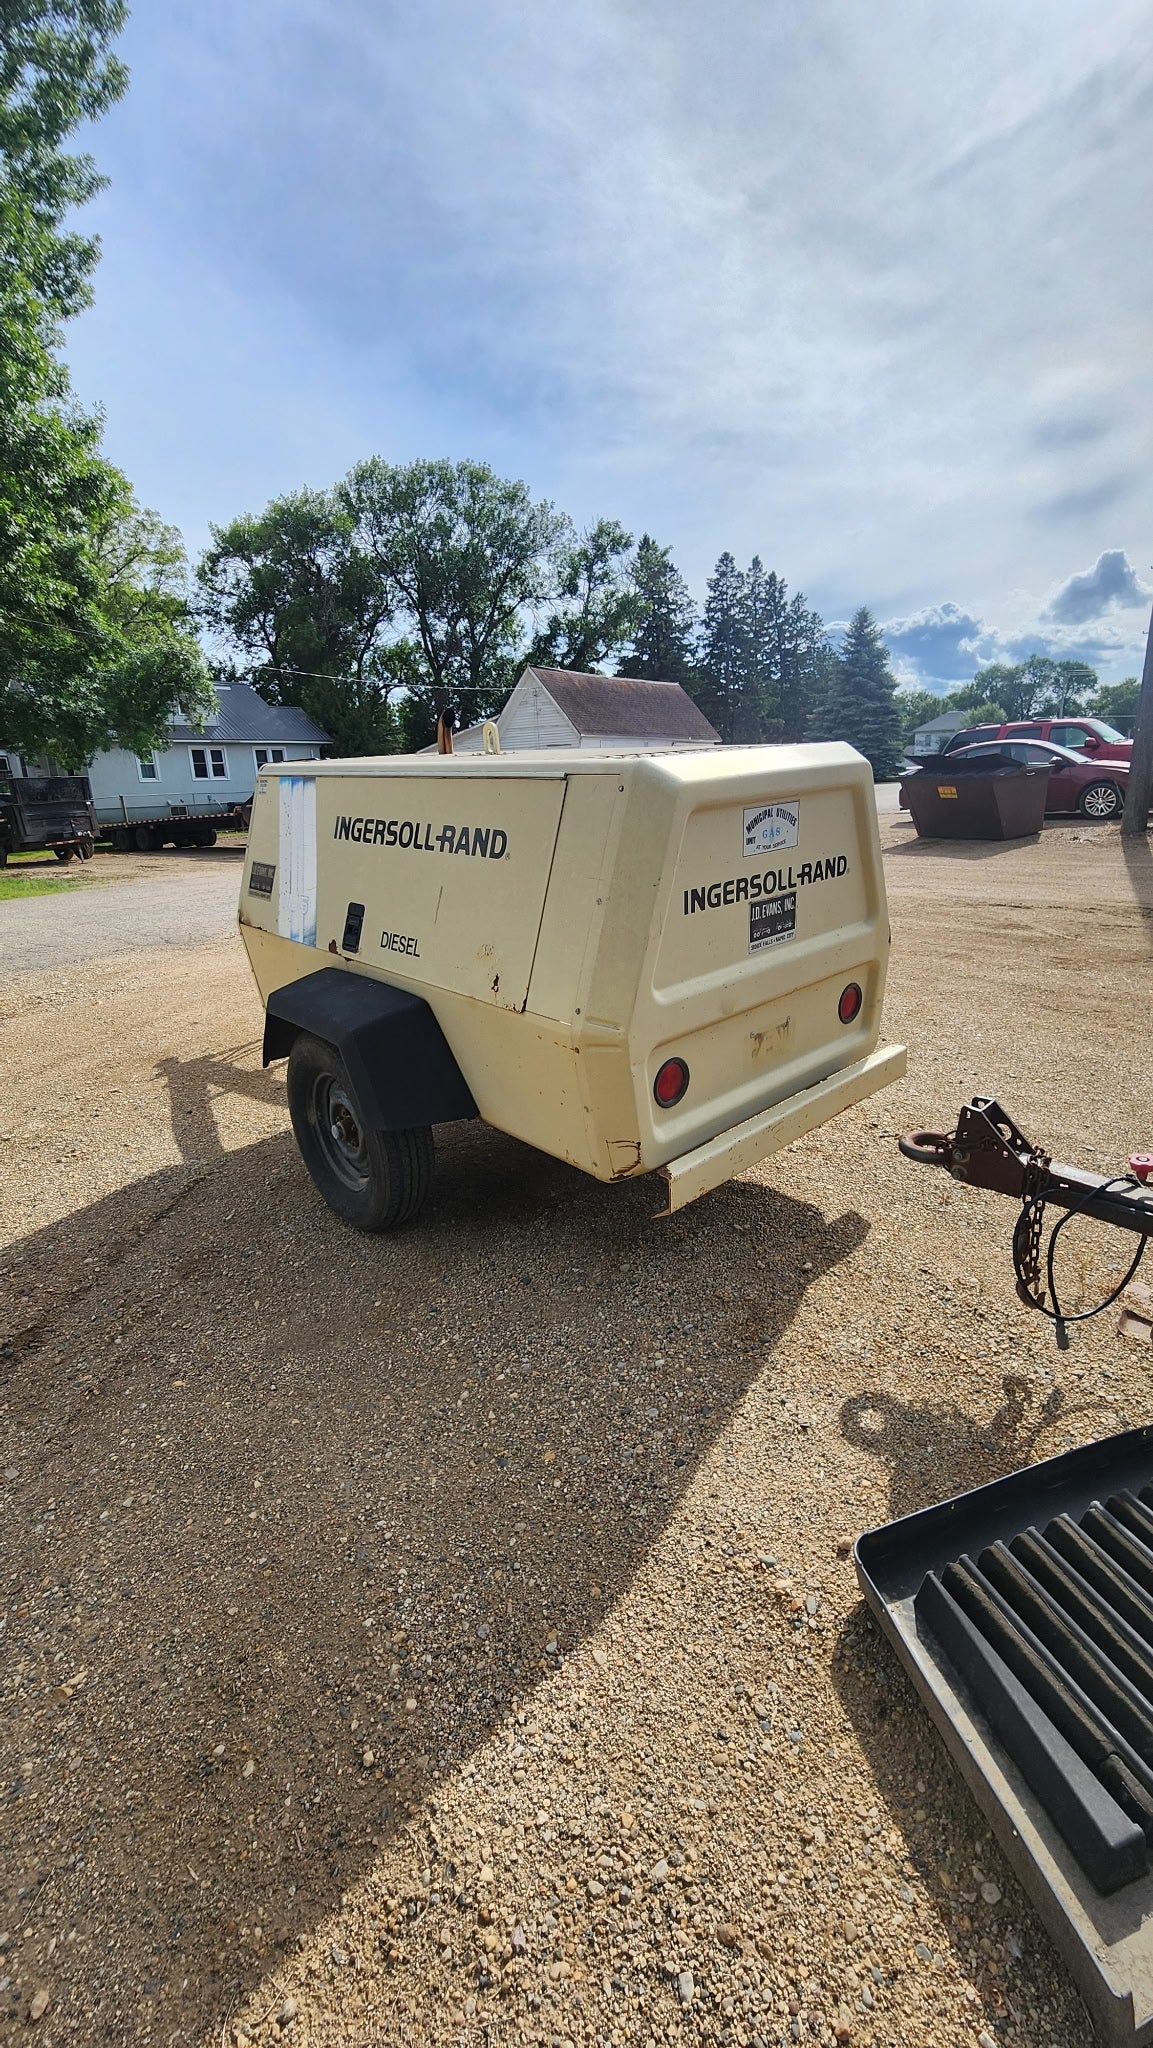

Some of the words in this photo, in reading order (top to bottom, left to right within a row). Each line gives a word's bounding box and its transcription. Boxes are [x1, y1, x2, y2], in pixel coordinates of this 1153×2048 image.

[746, 808, 774, 834] MUNICIPAL
[776, 808, 797, 827] UTILITIES
[762, 827, 781, 838] GAS
[334, 815, 508, 860] INGERSOLL-RAND
[746, 836, 756, 845] UNIT
[683, 855, 848, 915] INGERSOLL-RAND
[762, 900, 782, 918] EVANS,
[380, 931, 421, 957] DIESEL
